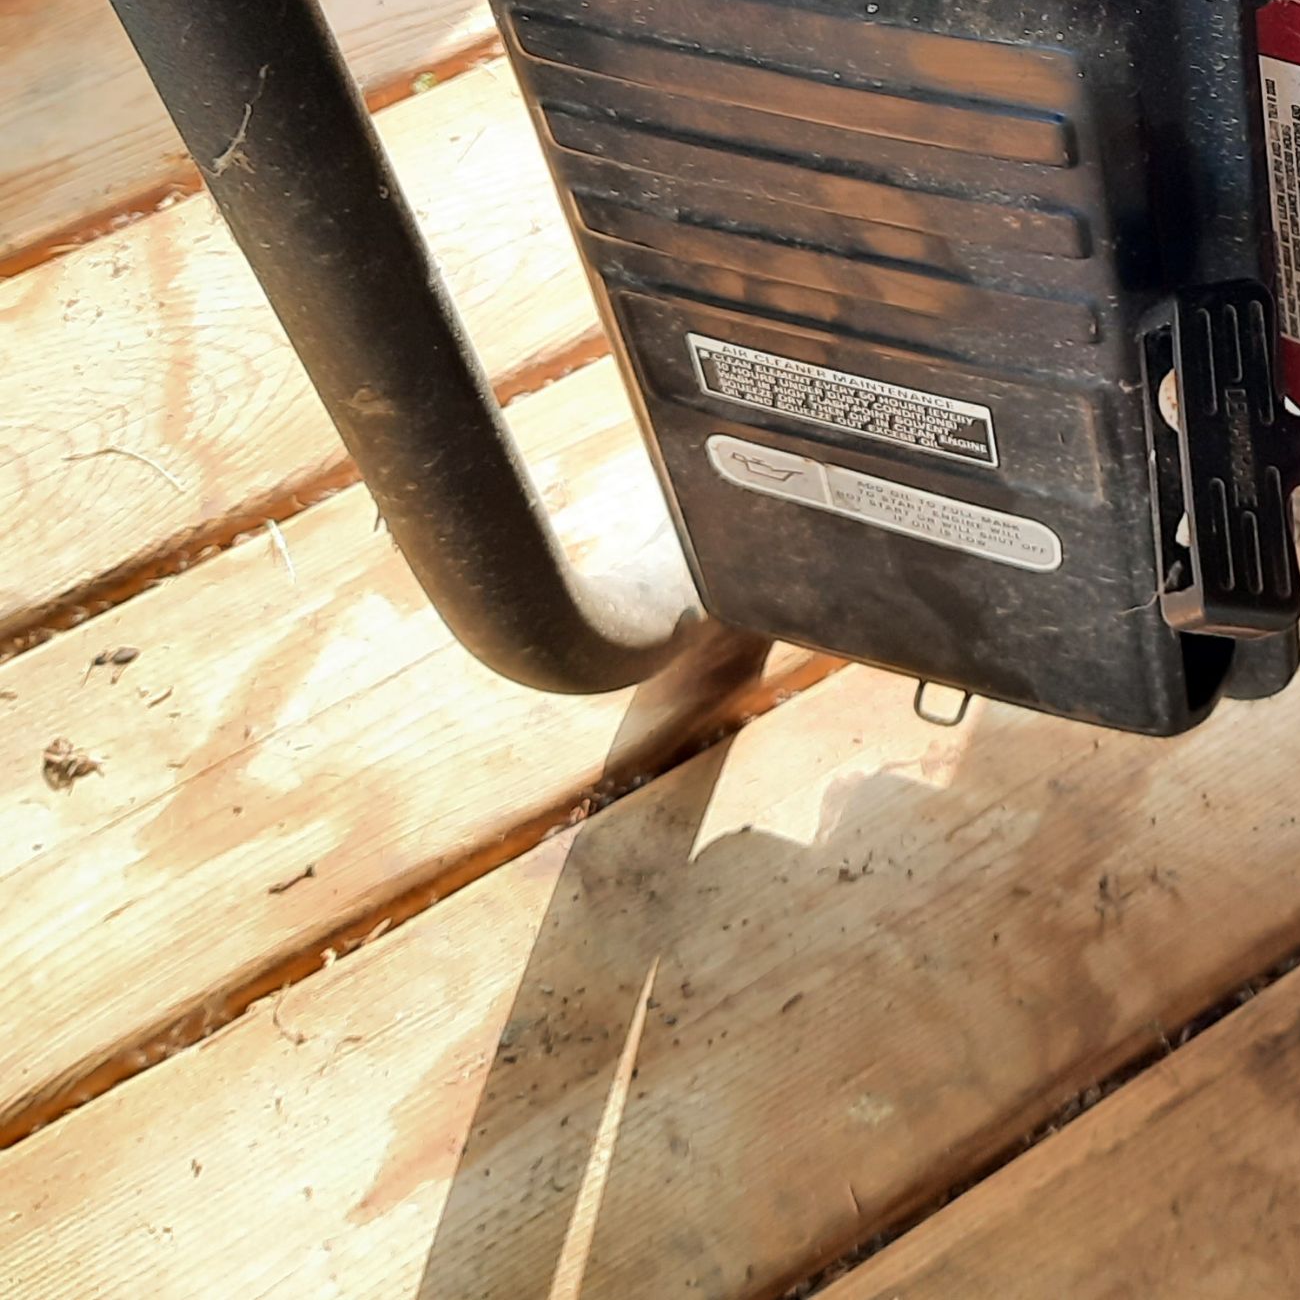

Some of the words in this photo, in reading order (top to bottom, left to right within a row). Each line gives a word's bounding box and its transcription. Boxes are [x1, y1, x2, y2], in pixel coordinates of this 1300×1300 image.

[711, 353, 751, 369] CLEAN
[815, 379, 856, 396] EVERY
[878, 395, 924, 413] HOURS
[721, 345, 747, 358] AIR
[753, 353, 825, 377] CLEANER
[832, 372, 953, 410] MAINTENANCE
[731, 366, 775, 383] HOURS
[778, 378, 823, 395] UNDER
[826, 390, 869, 407] DUSTY
[773, 384, 805, 398] HIGH
[852, 405, 890, 420] POINT
[836, 416, 863, 428] OUT
[893, 423, 935, 439] CLEAN
[939, 433, 987, 453] ENGINE
[857, 481, 882, 492] ADD
[890, 490, 910, 500] OIL
[919, 499, 934, 507] TO
[942, 505, 971, 517] FULL
[981, 516, 1019, 530] MARK
[858, 488, 874, 497] TO
[882, 495, 921, 510] START
[931, 510, 980, 528] ENGINE
[990, 526, 1019, 538] WILL
[869, 499, 908, 515] START
[942, 521, 970, 533] WILL
[979, 531, 1013, 545] SHUT
[1021, 543, 1044, 553] OFF
[912, 520, 931, 530] OIL
